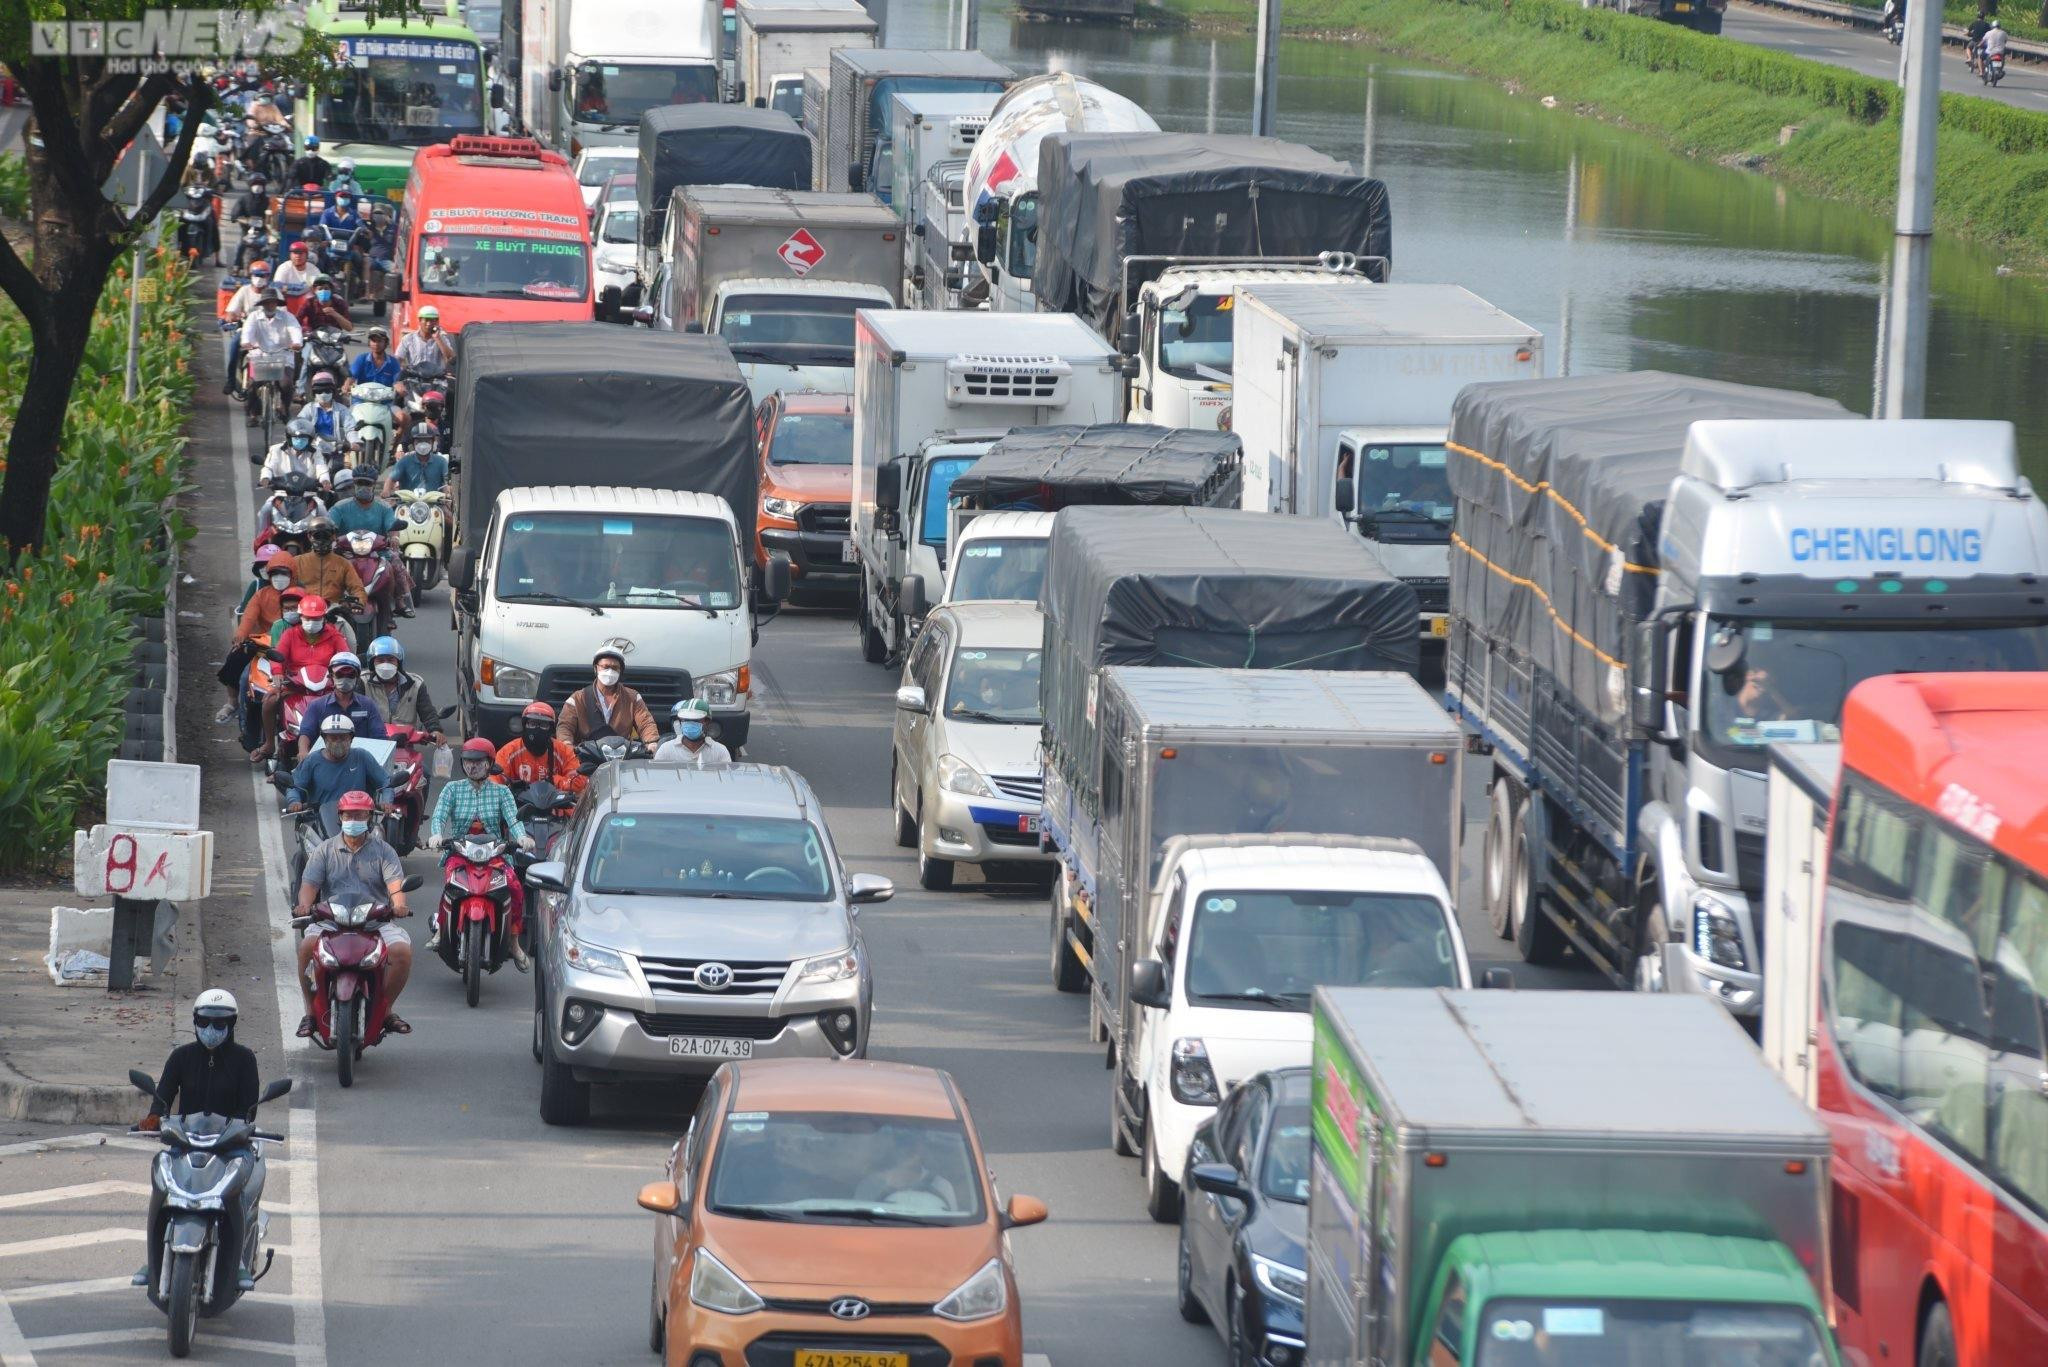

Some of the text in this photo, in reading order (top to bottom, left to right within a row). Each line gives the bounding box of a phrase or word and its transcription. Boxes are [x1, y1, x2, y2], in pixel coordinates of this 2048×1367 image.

[431, 206, 578, 225] XE BUÝT PHƯƠNG TRANG
[475, 240, 581, 256] XE BUÝT PHƯƠNG
[972, 365, 1051, 375] THERMAL MASTER
[1790, 527, 1982, 562] CHENGLONG
[671, 1037, 751, 1057] 62A-074.39
